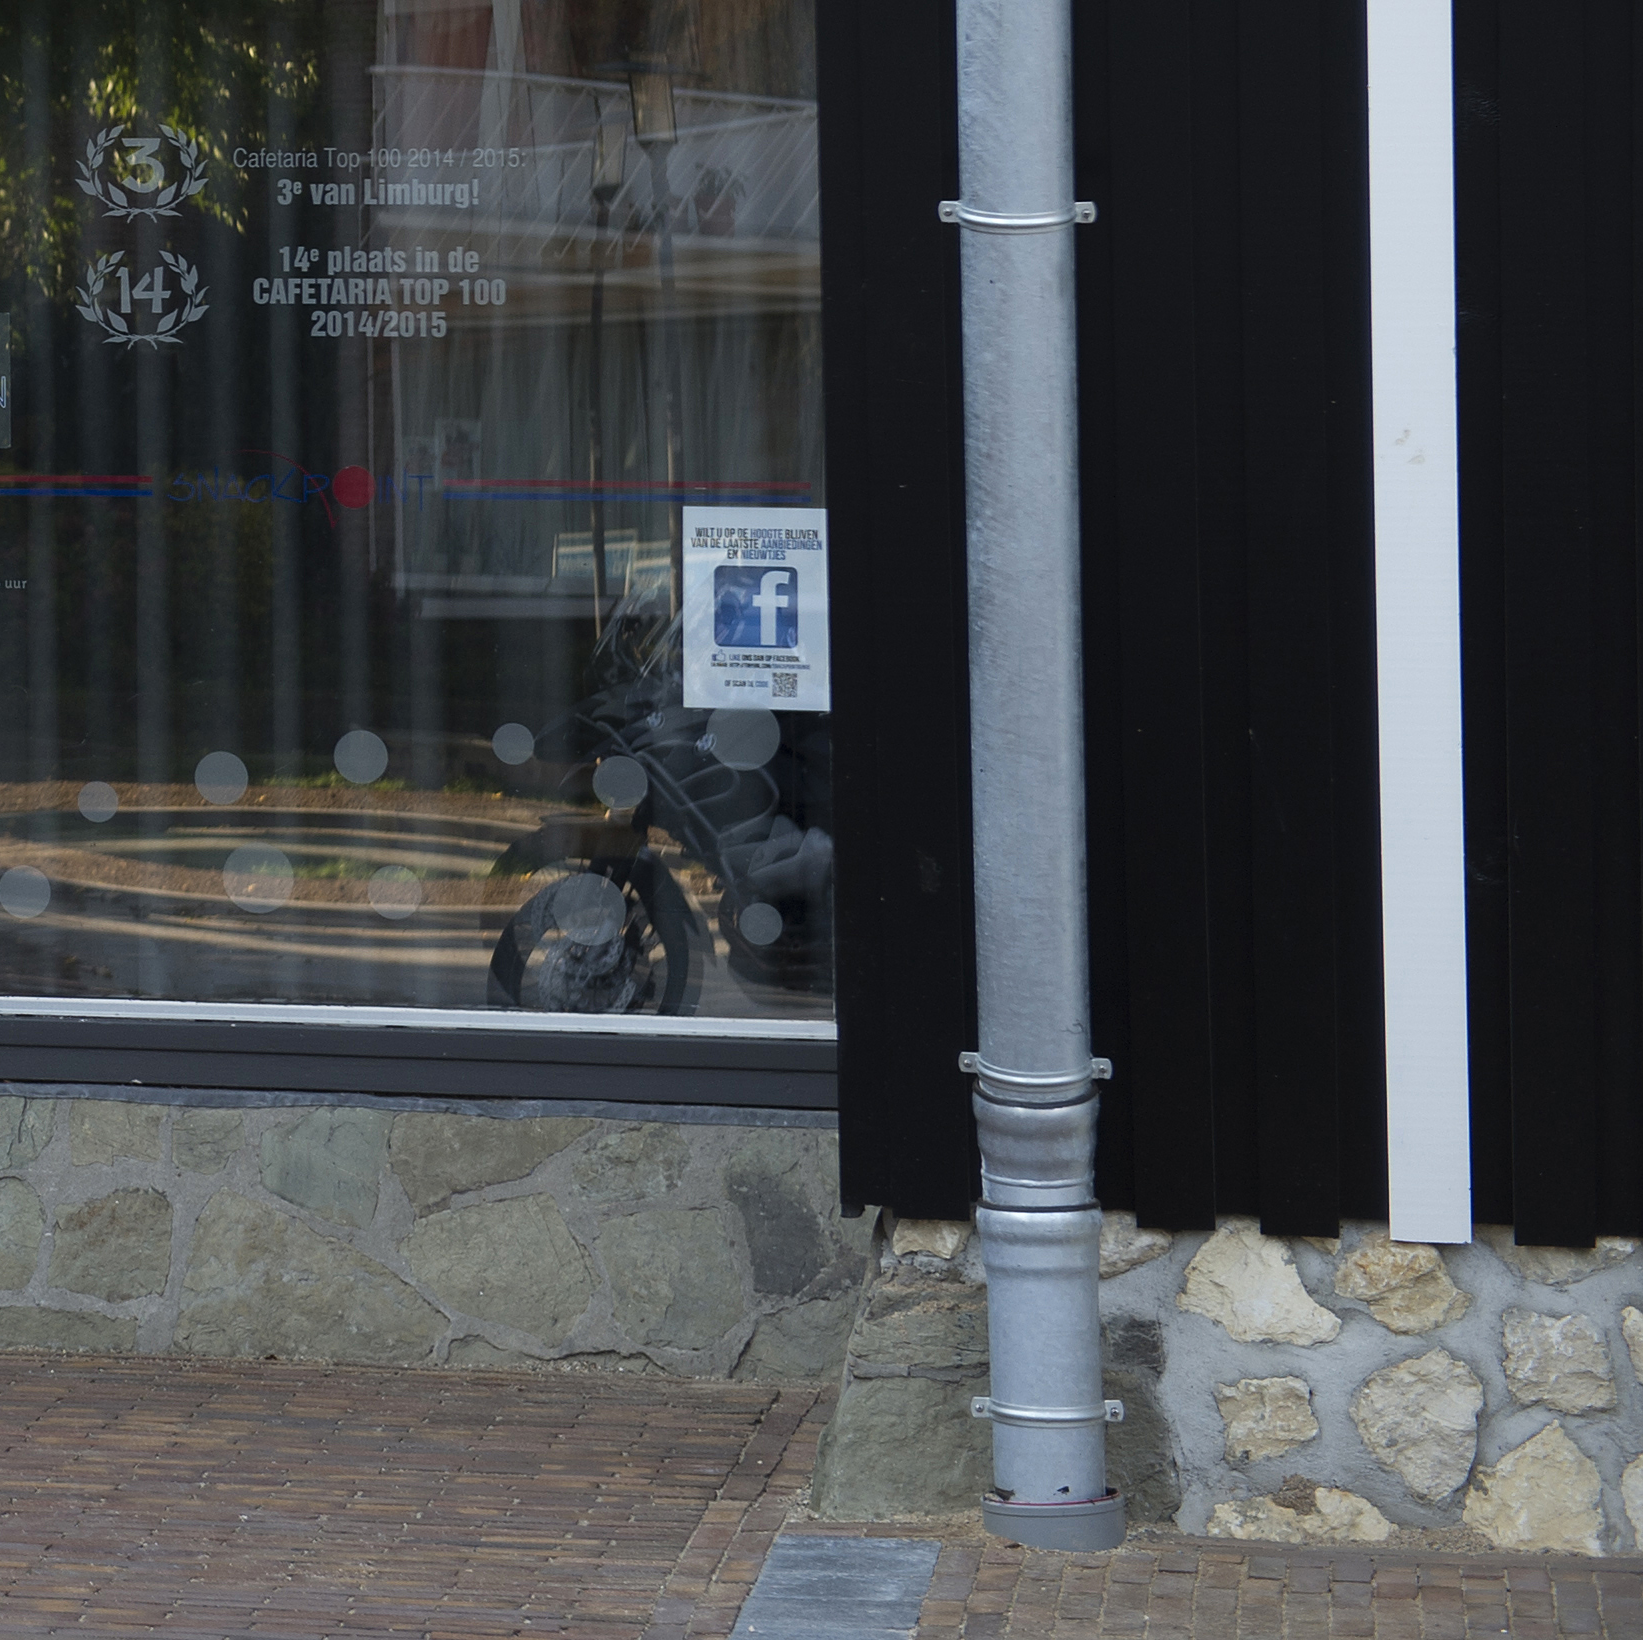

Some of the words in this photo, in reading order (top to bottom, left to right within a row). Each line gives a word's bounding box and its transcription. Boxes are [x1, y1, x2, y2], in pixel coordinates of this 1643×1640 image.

[121, 137, 165, 194] 3
[233, 147, 318, 169] Cafetaria
[323, 148, 360, 172] Top
[366, 148, 408, 168] 100
[412, 148, 454, 168] 2014
[474, 148, 526, 168] 2015:
[310, 182, 355, 205] van
[364, 179, 480, 209] Limburg!
[327, 246, 407, 275] plaats
[416, 247, 440, 272] in
[446, 247, 479, 272] de
[115, 266, 171, 314] 14
[253, 278, 393, 305] CAFETARIA
[400, 278, 449, 305] TOP
[459, 279, 506, 305] 100
[311, 310, 447, 338] 2014/2015
[691, 537, 708, 548] VAN
[710, 538, 720, 548] DE
[723, 538, 759, 549] LAATSTE
[761, 539, 822, 550] AANBIEDINGEN
[695, 527, 715, 538] WILT
[716, 528, 722, 538] U
[724, 528, 735, 538] OP
[737, 528, 748, 539] DE
[750, 528, 783, 539] HOOGTE
[741, 549, 786, 560] NIEUWTJES
[4, 579, 28, 589] uur
